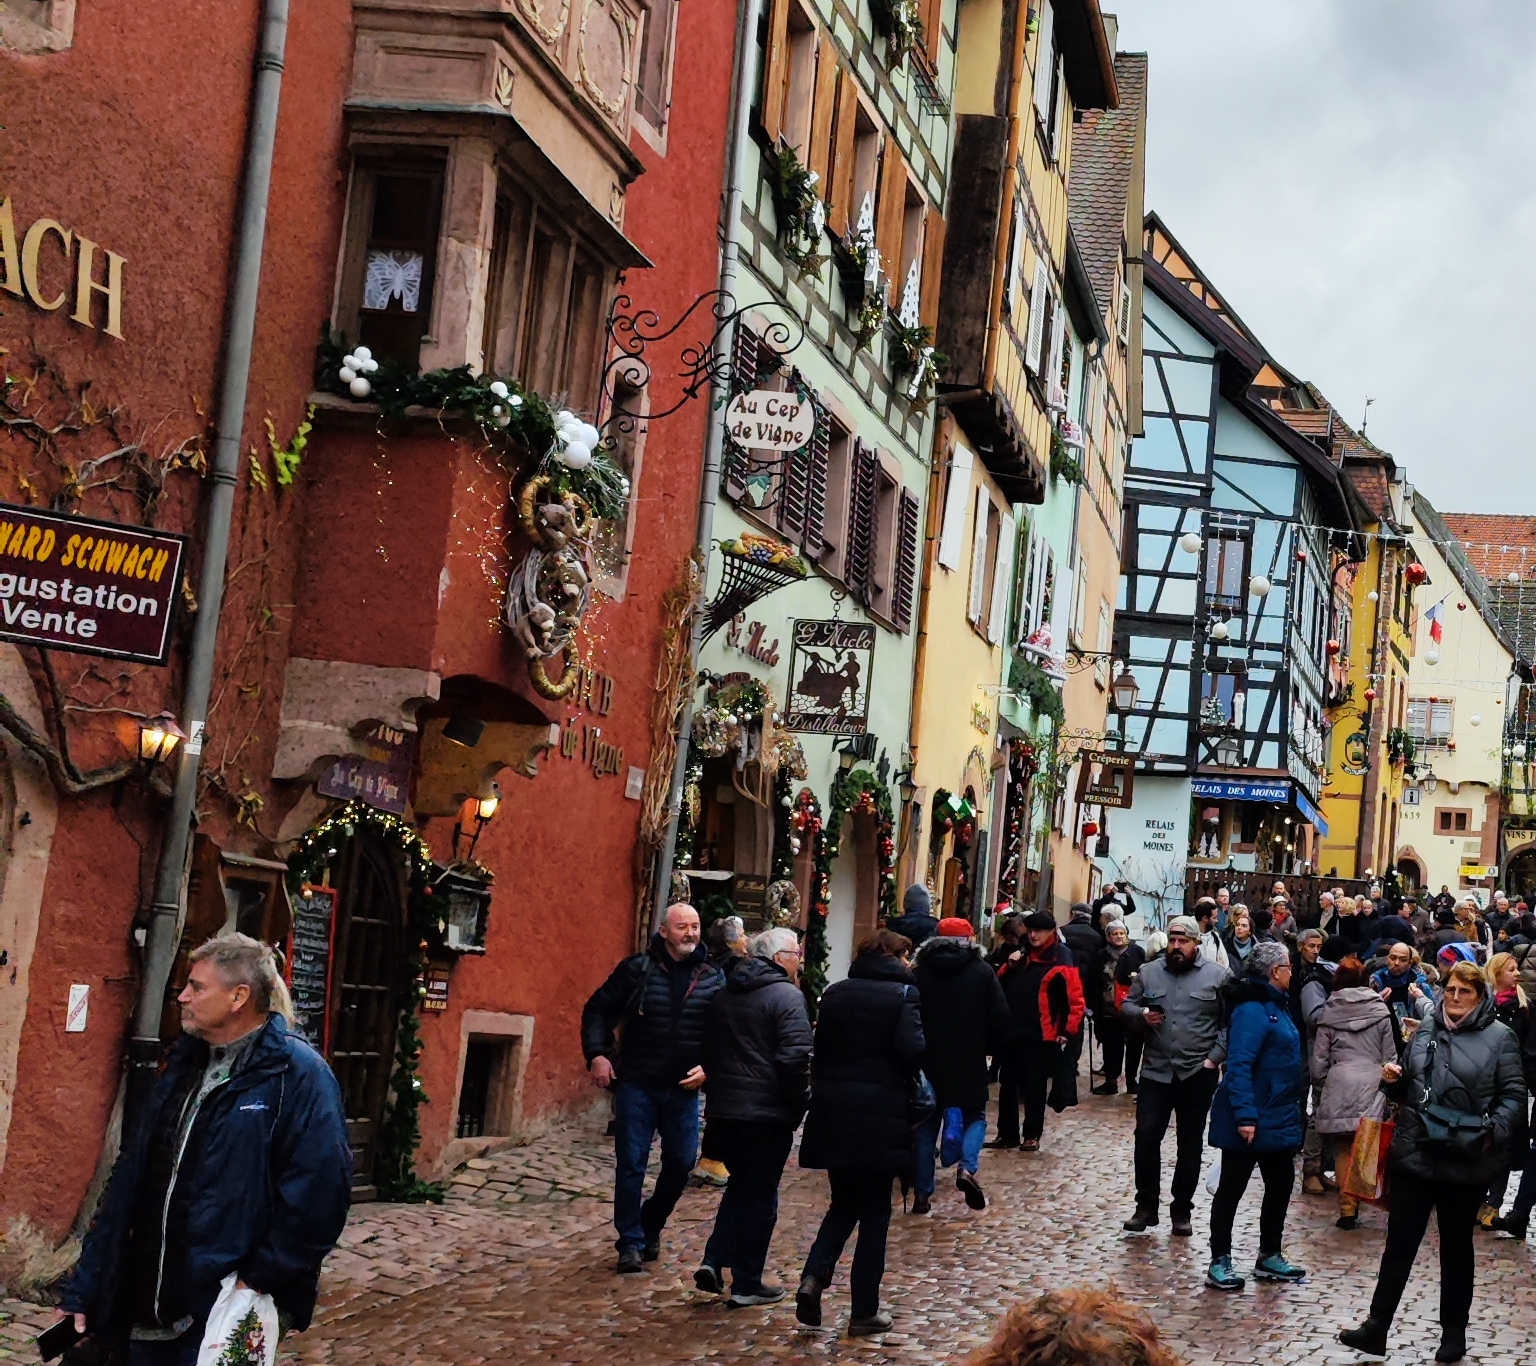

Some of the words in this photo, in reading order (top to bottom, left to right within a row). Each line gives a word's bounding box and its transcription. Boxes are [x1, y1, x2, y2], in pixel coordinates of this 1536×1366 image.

[733, 396, 758, 415] Au
[765, 398, 799, 423] Cep
[731, 420, 752, 440] de
[756, 422, 804, 447] Vigne
[60, 533, 169, 584] SCHWACH
[2, 598, 98, 638] Vente
[817, 622, 874, 650] Miclo
[787, 713, 866, 736] Distillateur
[1227, 786, 1246, 795] DES
[1250, 788, 1286, 798] MOINES
[1145, 819, 1175, 831] RELAIS
[1506, 830, 1526, 840] VINS
[1143, 841, 1174, 852] MOINES
